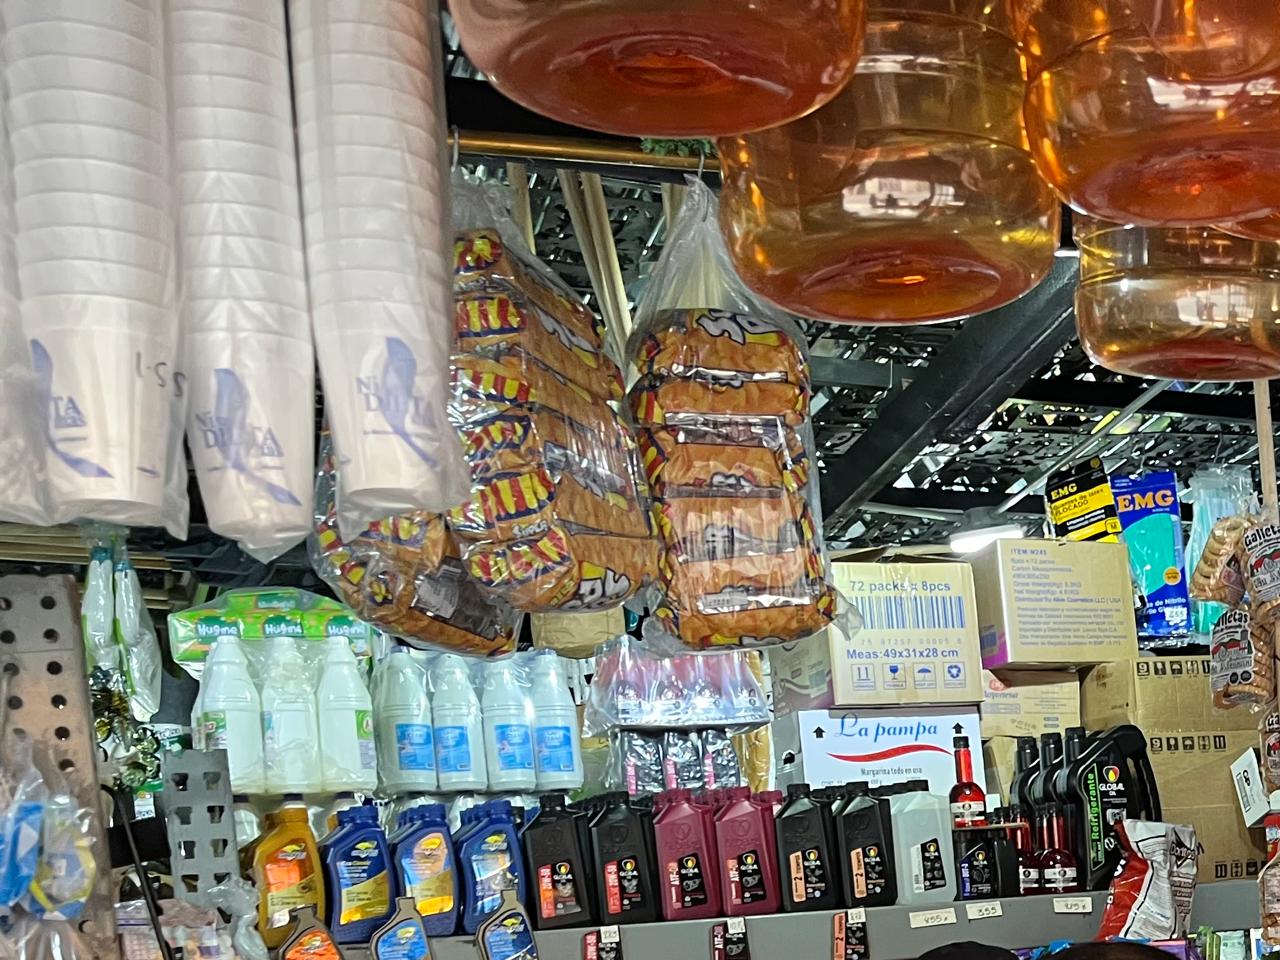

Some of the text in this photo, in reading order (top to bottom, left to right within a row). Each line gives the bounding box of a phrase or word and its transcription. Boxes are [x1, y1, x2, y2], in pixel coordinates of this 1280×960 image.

[1050, 483, 1078, 499] EMG
[1117, 490, 1175, 513] EMG
[851, 581, 864, 592] 72
[921, 581, 951, 592] 8pcs
[942, 649, 959, 658] cm
[833, 712, 938, 743] La pampa
[1098, 783, 1126, 791] GLOBAL
[1090, 772, 1101, 841] Refrigerante
